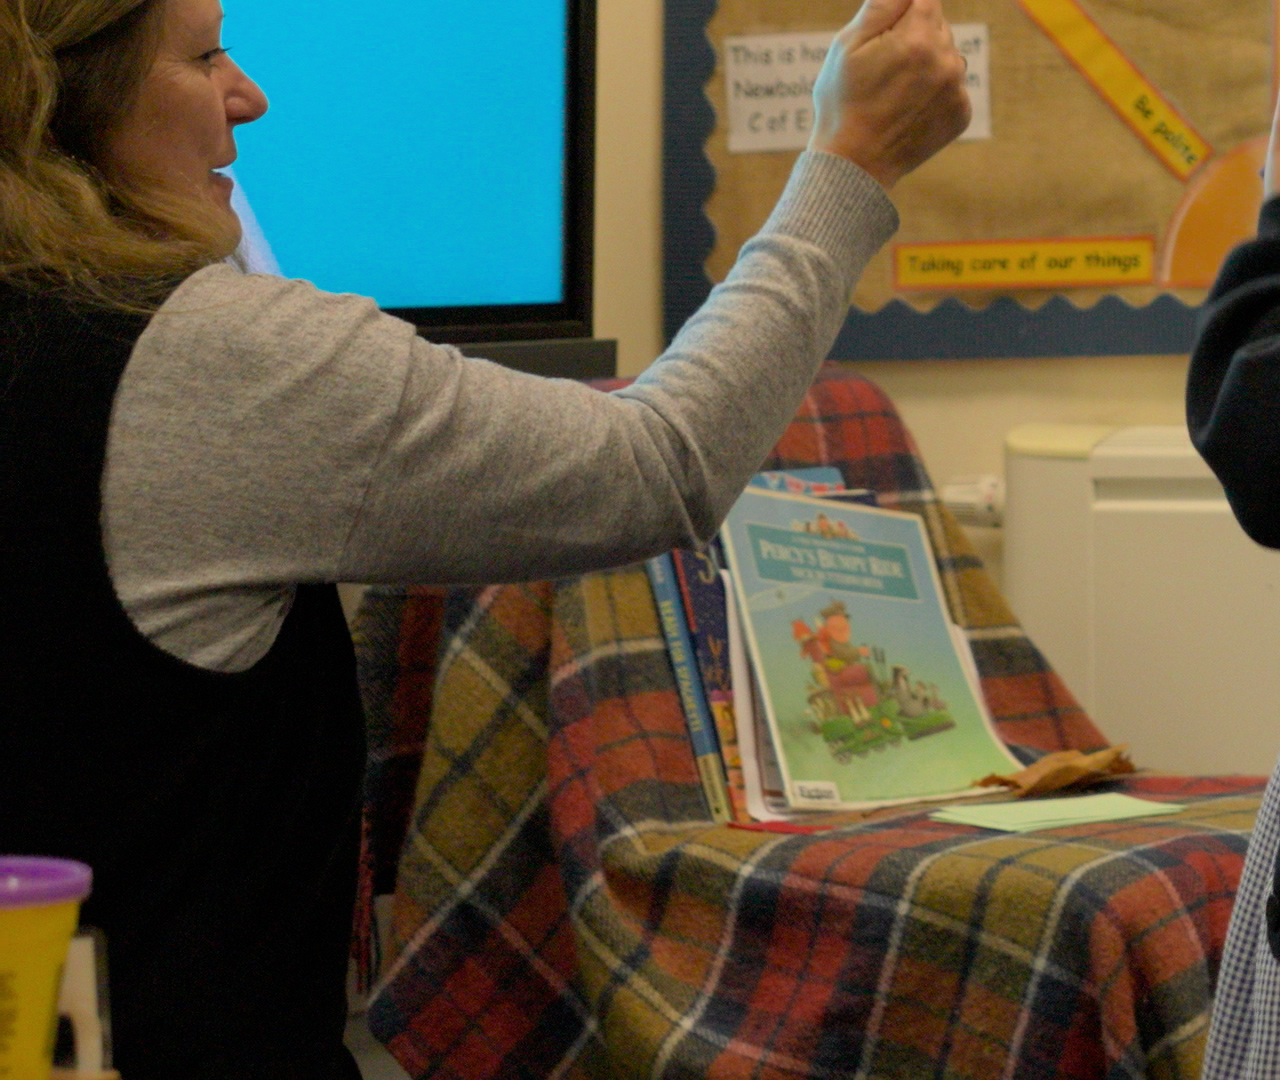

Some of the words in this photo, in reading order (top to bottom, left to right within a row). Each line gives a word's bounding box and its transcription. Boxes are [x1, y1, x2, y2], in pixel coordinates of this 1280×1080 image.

[731, 45, 772, 65] This
[780, 46, 795, 64] is
[748, 111, 763, 134] C
[767, 108, 789, 132] of
[795, 108, 809, 133] E
[1133, 94, 1154, 120] Be
[1151, 122, 1199, 165] polite
[908, 254, 963, 277] Taking
[970, 256, 1010, 271] care
[1018, 251, 1038, 270] of
[1046, 255, 1077, 270] our
[1084, 251, 1141, 274] things
